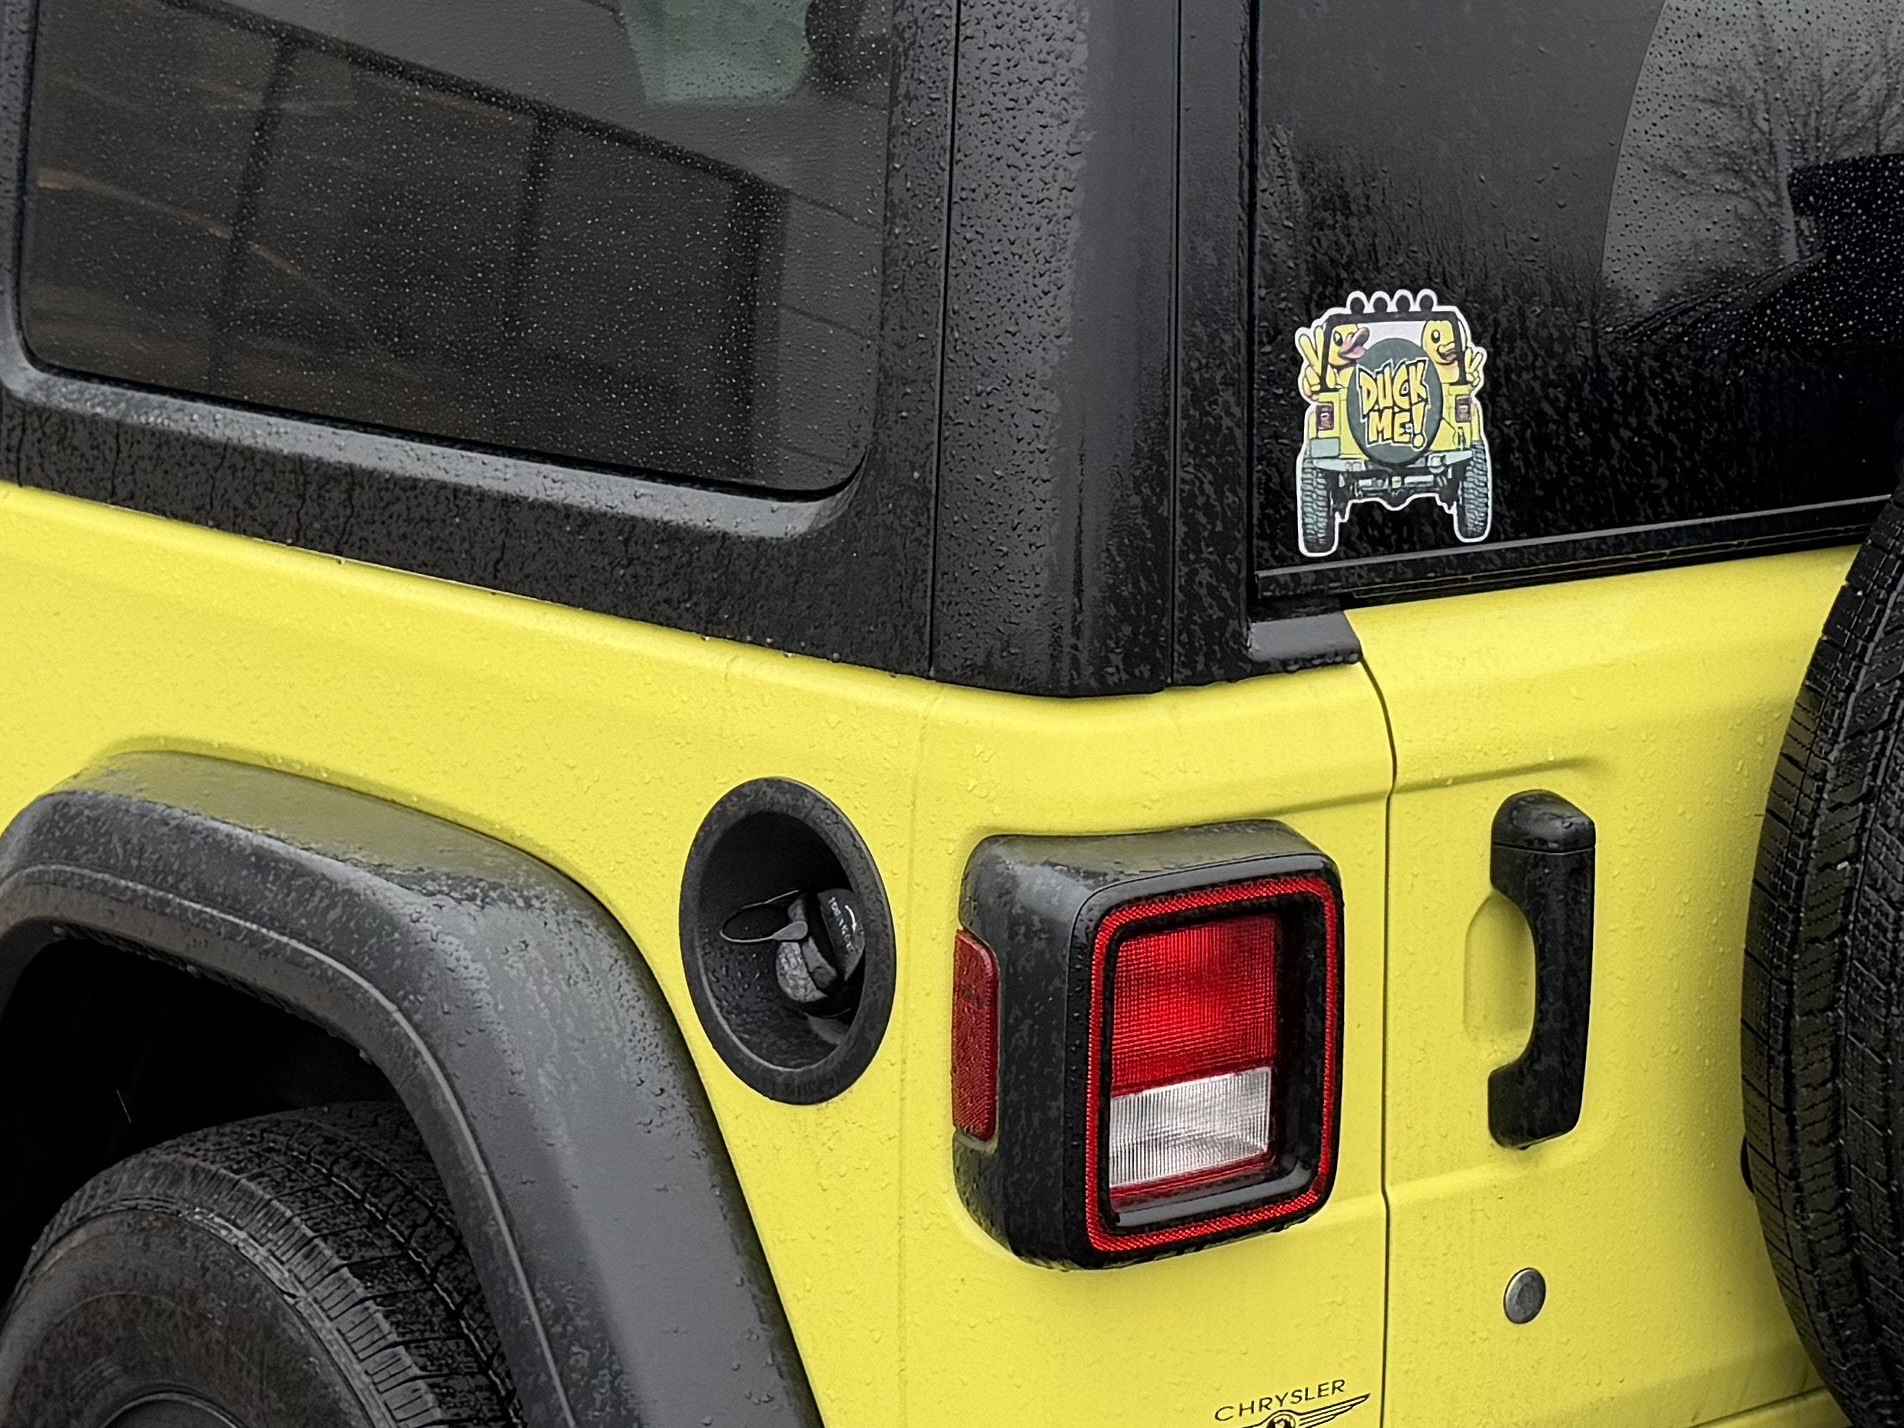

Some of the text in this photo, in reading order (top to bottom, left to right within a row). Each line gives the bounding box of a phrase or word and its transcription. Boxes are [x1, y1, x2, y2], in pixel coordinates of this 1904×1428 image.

[1357, 358, 1429, 417] DUCK
[1366, 402, 1428, 451] ME!
[1214, 1379, 1346, 1422] CHRYSLER
